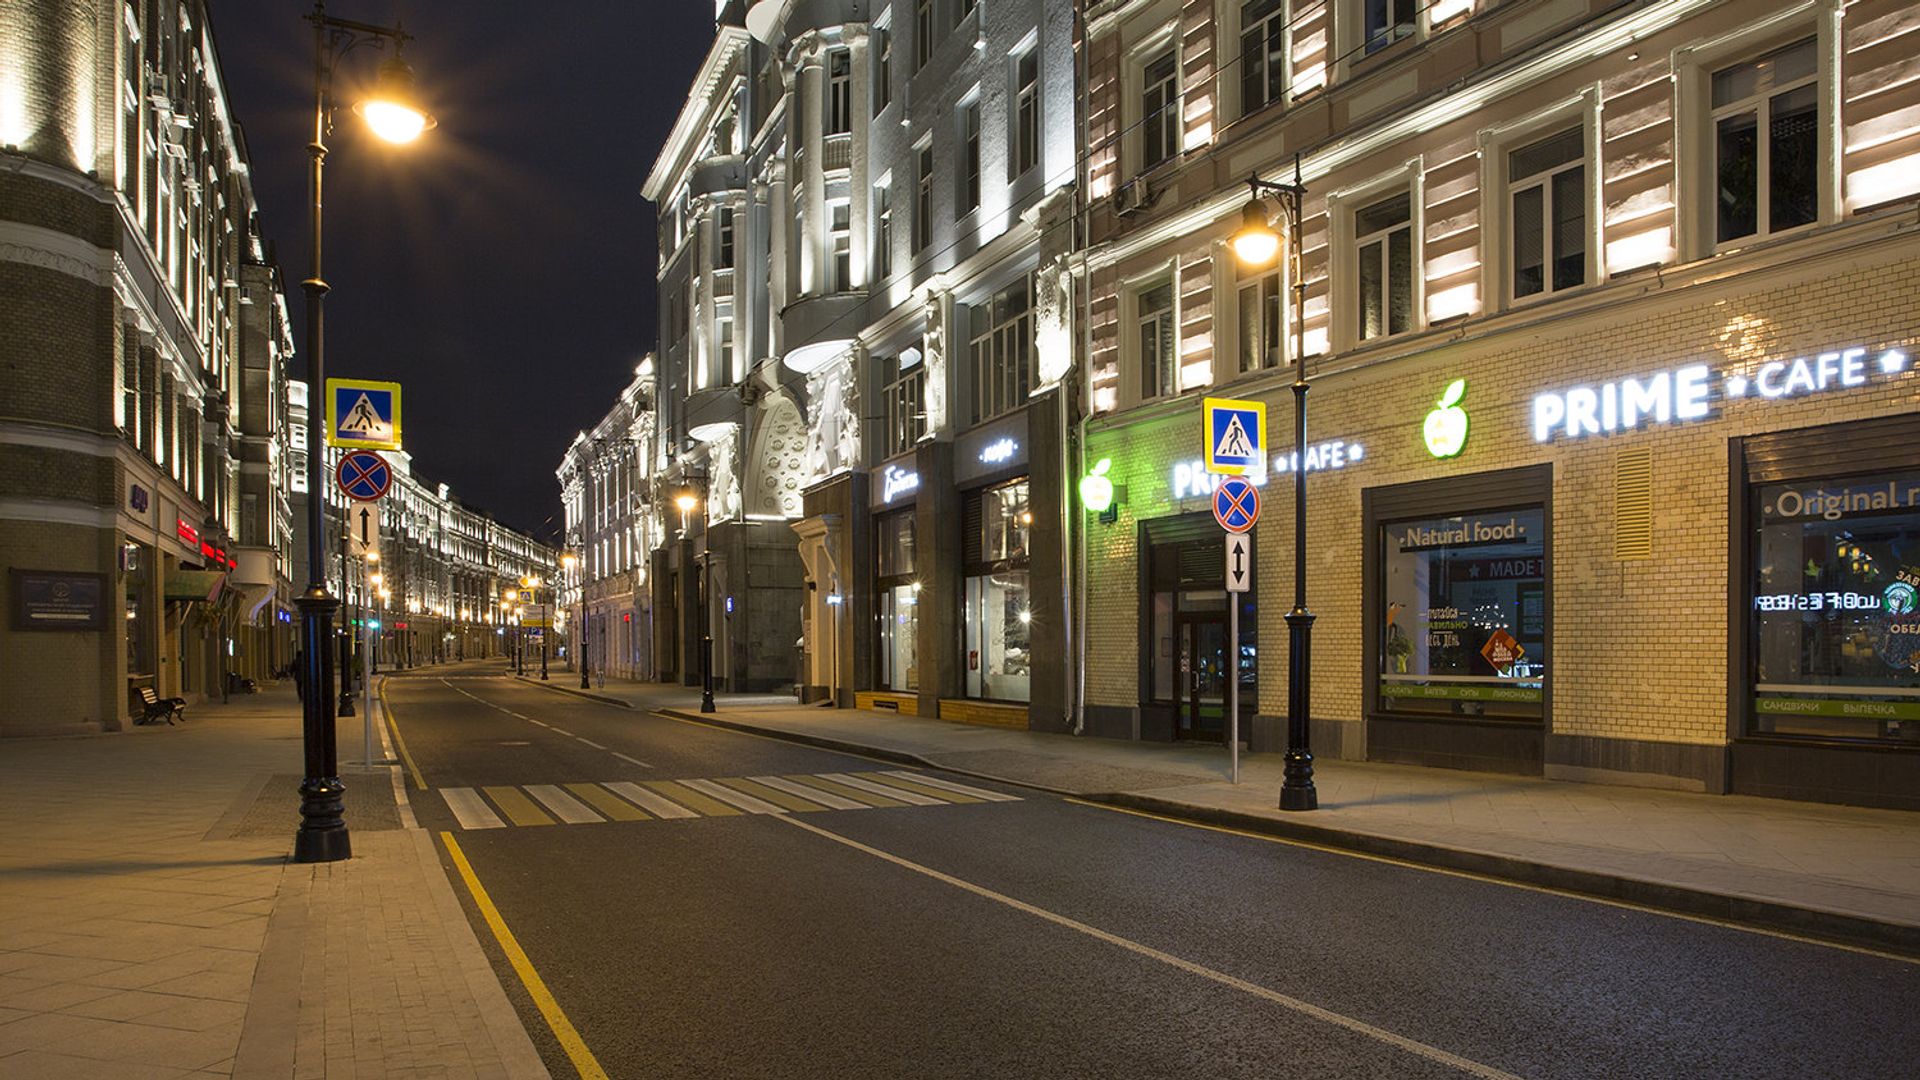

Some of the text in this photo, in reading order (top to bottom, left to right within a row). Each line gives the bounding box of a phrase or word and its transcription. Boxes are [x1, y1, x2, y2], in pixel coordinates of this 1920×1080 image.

[1534, 348, 1866, 442] PRIME CAFE
[1776, 480, 1900, 521] Original
[1407, 518, 1516, 547] Natural food
[1489, 560, 1535, 578] MADE
[1895, 570, 1920, 587] ЗАВ
[1763, 701, 1896, 715] САНДВИЧИ ВЫПЕЧКА
